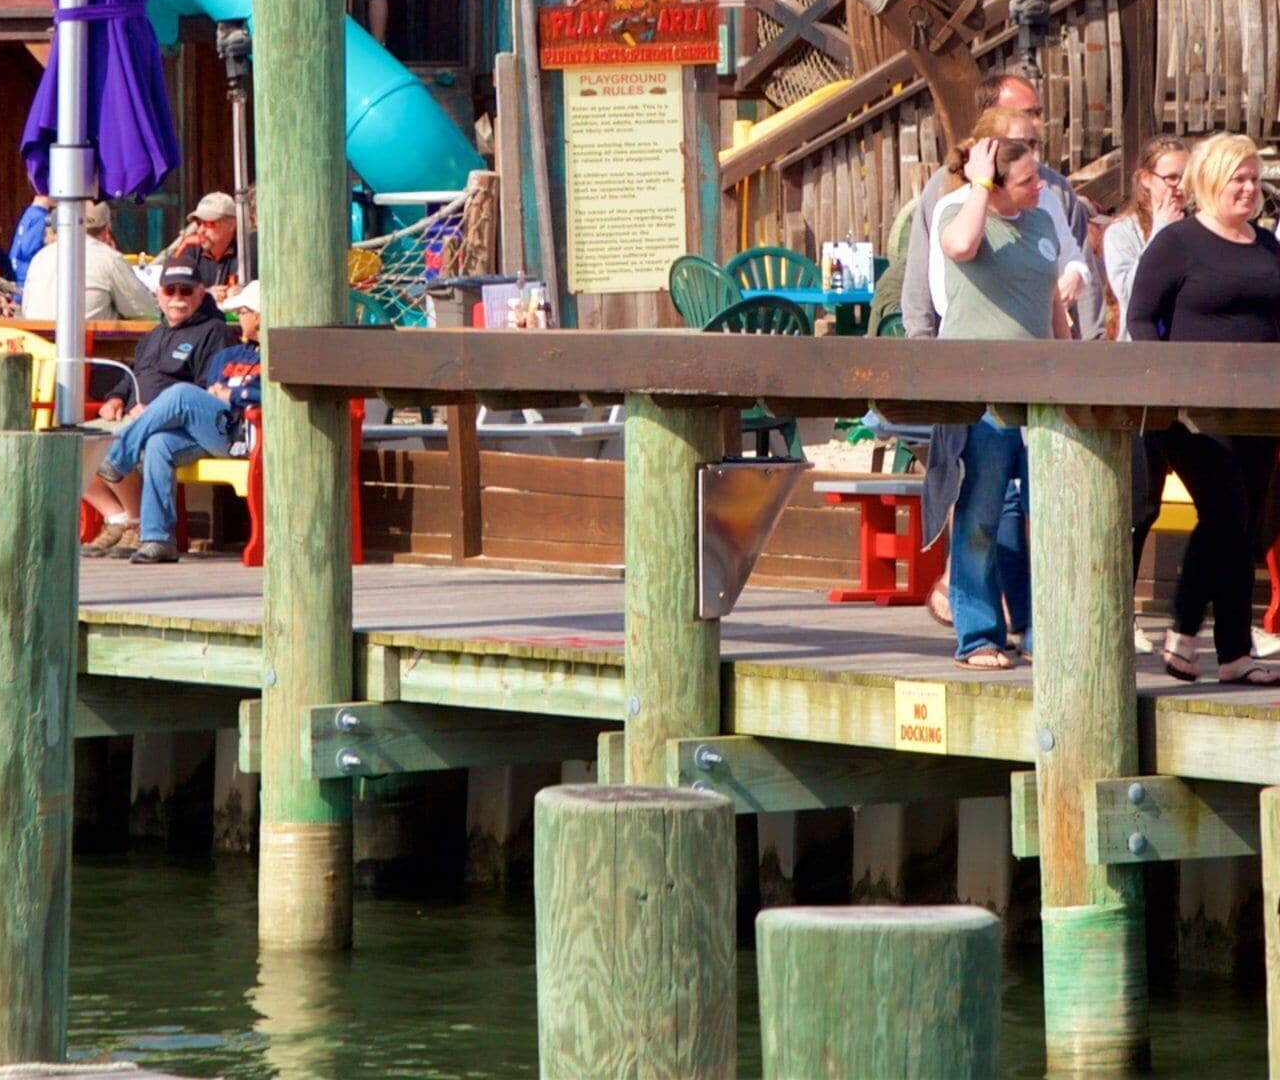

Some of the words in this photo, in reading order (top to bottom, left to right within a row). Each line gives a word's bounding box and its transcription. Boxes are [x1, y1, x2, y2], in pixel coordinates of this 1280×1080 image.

[550, 10, 607, 38] PLAY
[657, 8, 708, 33] AREA
[580, 72, 666, 85] PLAYGROUND
[603, 85, 645, 96] RULES
[913, 703, 928, 721] NO
[900, 724, 942, 744] DOCKING
